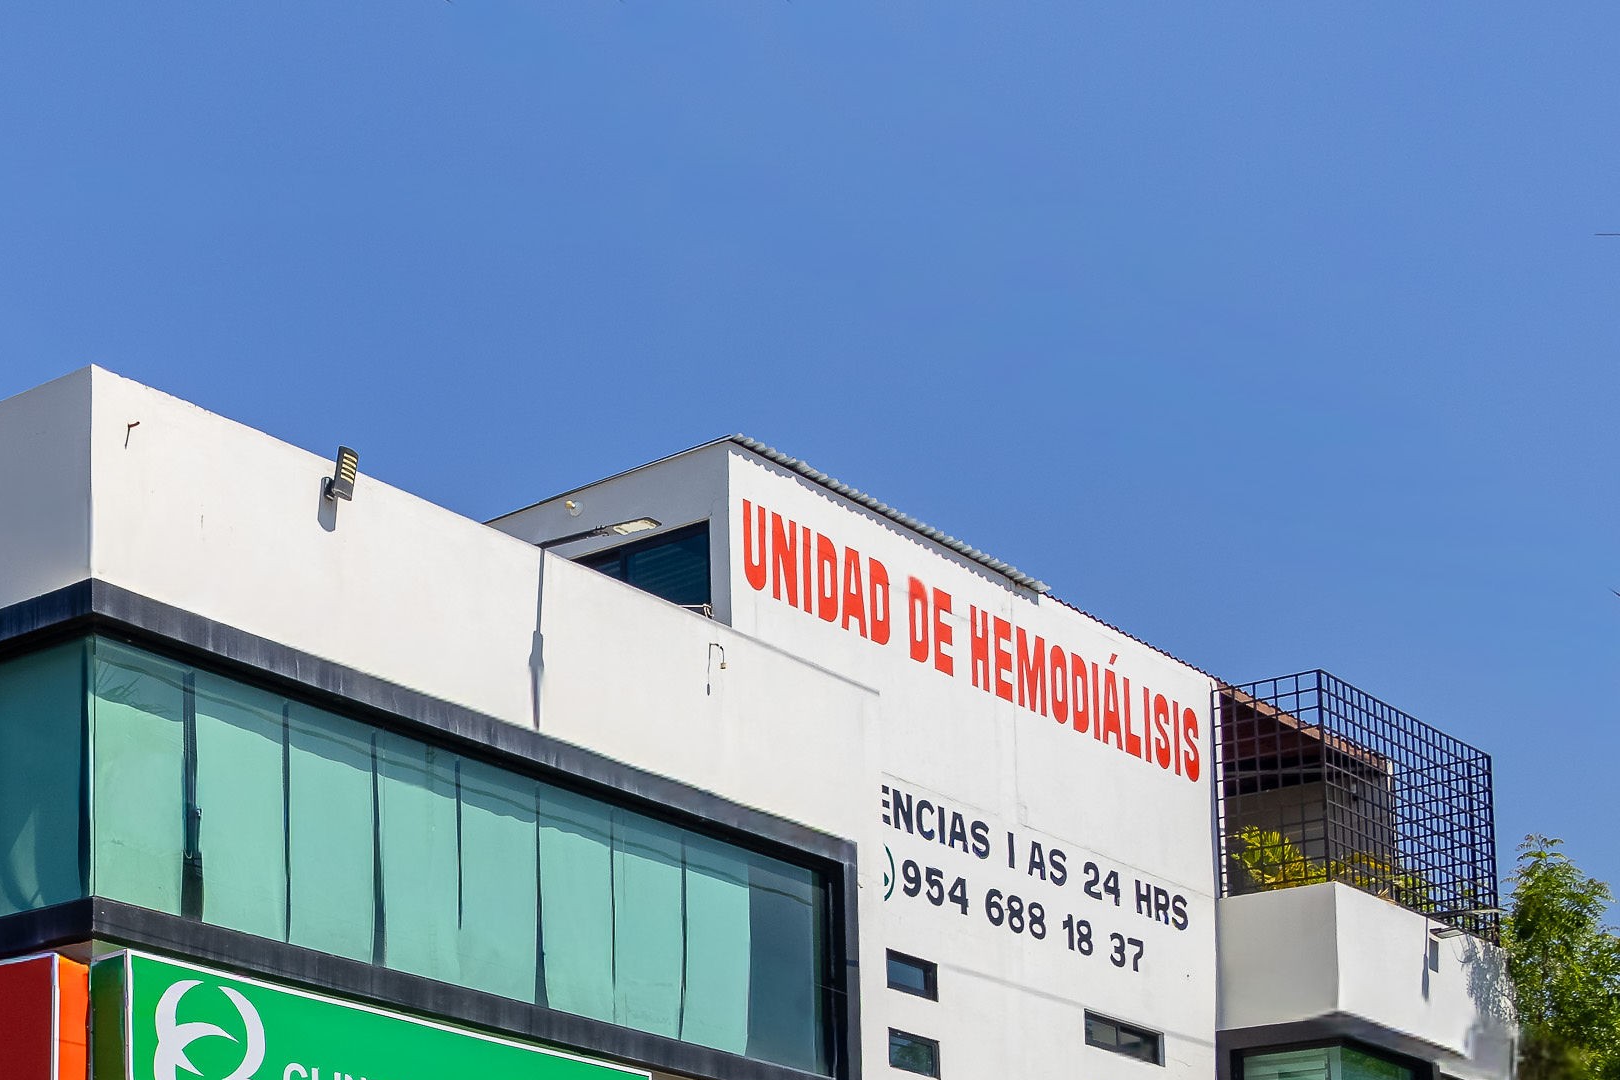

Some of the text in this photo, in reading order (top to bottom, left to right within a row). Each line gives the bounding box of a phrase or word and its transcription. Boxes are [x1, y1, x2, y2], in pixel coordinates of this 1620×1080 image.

[742, 498, 1201, 782] UNIDAD DE HEMODIÁLISIS
[902, 859, 1144, 973] 954 688 18 37
[1083, 861, 1121, 907] 24
[1135, 879, 1189, 931] HRS
